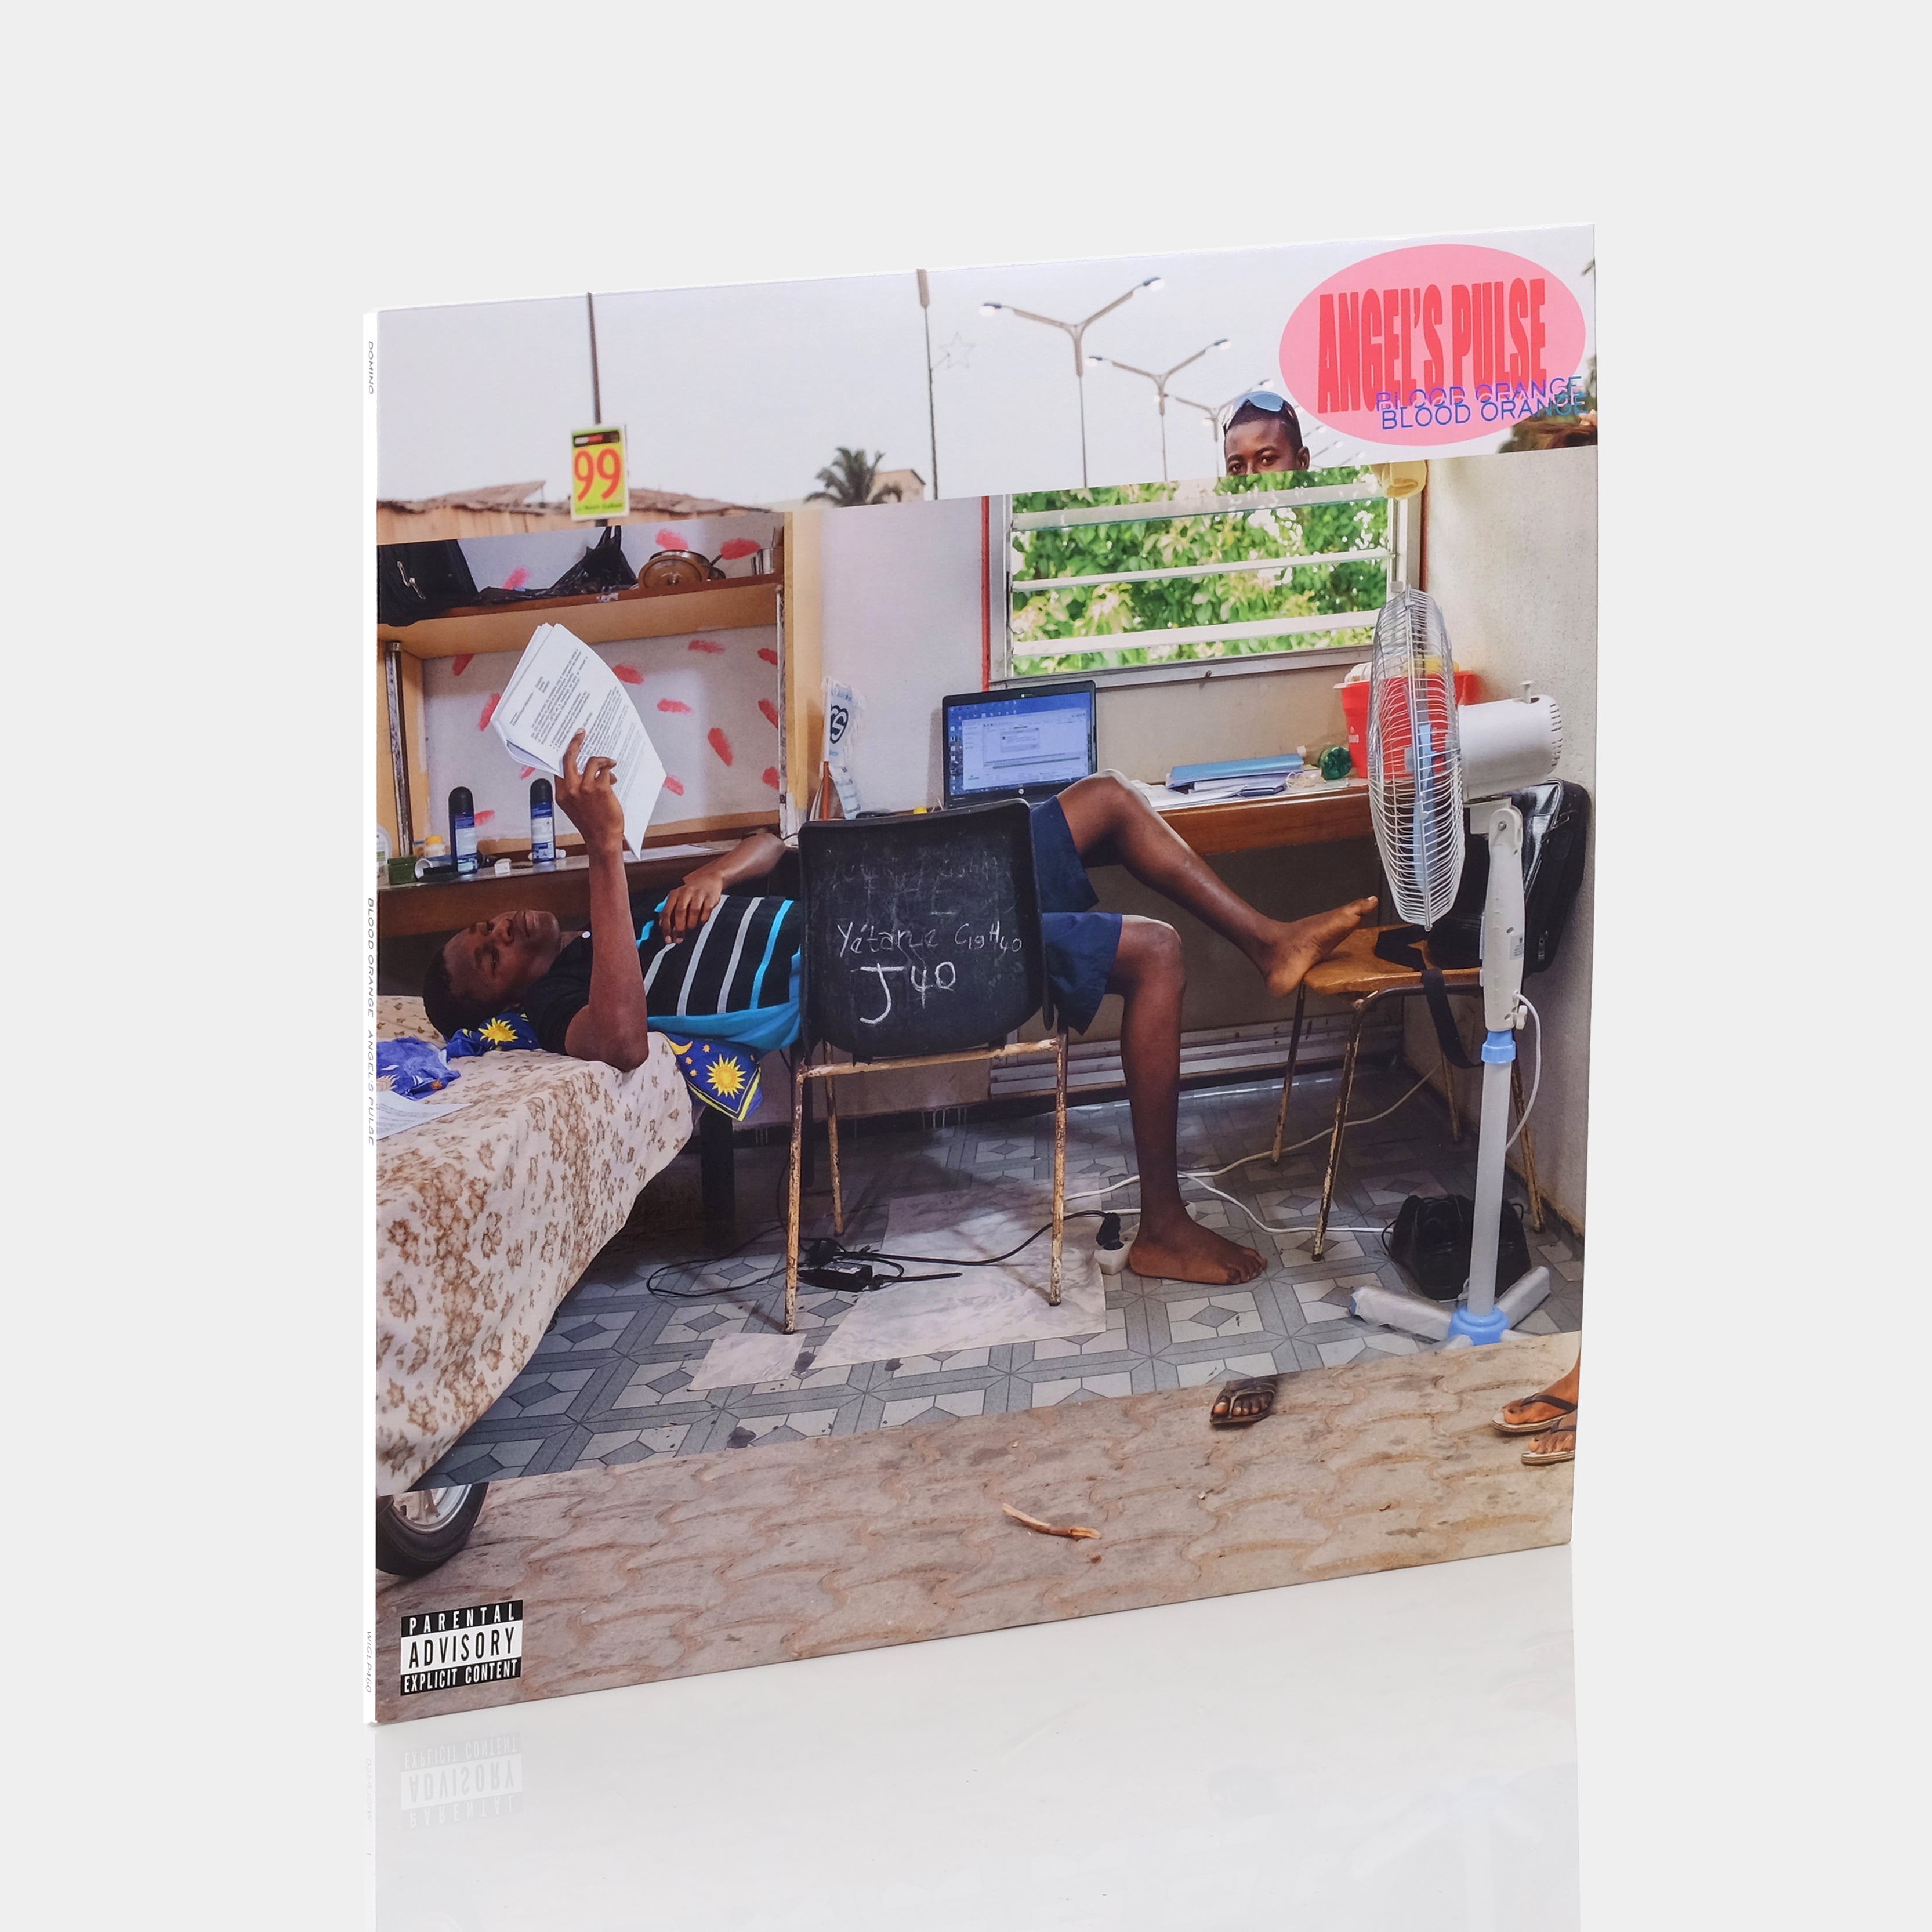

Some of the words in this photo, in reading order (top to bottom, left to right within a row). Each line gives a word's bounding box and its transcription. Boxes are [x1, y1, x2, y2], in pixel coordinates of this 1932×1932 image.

[1317, 284, 1445, 414] ANGEL'S
[1451, 277, 1547, 397] PULSE
[1382, 401, 1471, 430] BLOOD
[1480, 391, 1589, 422] ORANGE
[574, 447, 621, 502] 99
[409, 1603, 514, 1636] PARENTAL
[408, 1626, 515, 1669] ADVISORY
[404, 1668, 458, 1693] EXPLICIT
[465, 1659, 518, 1684] CONTENT
